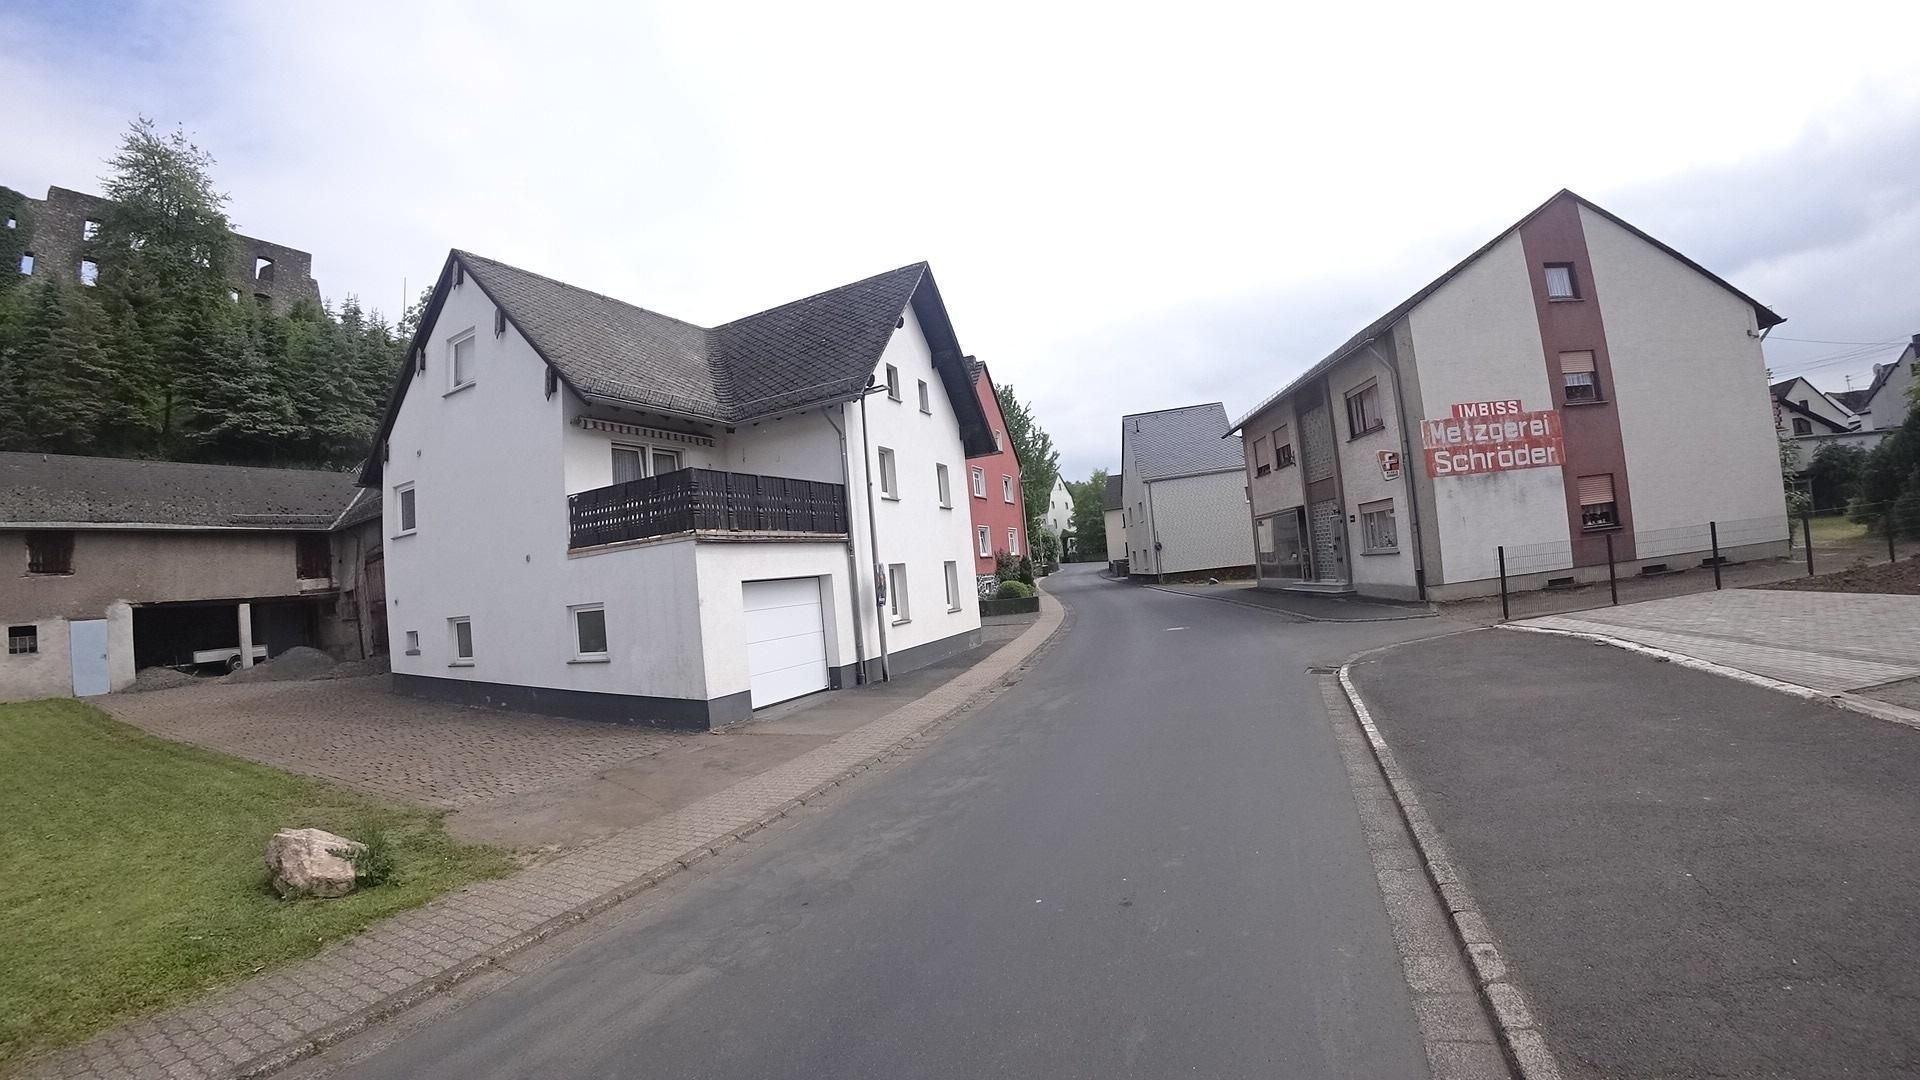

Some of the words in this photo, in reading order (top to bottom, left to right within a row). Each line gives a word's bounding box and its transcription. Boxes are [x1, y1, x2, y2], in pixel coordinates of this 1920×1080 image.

[1458, 401, 1518, 418] IMBISS
[1429, 414, 1550, 444] Metzgerei
[1434, 443, 1556, 473] Schröder
